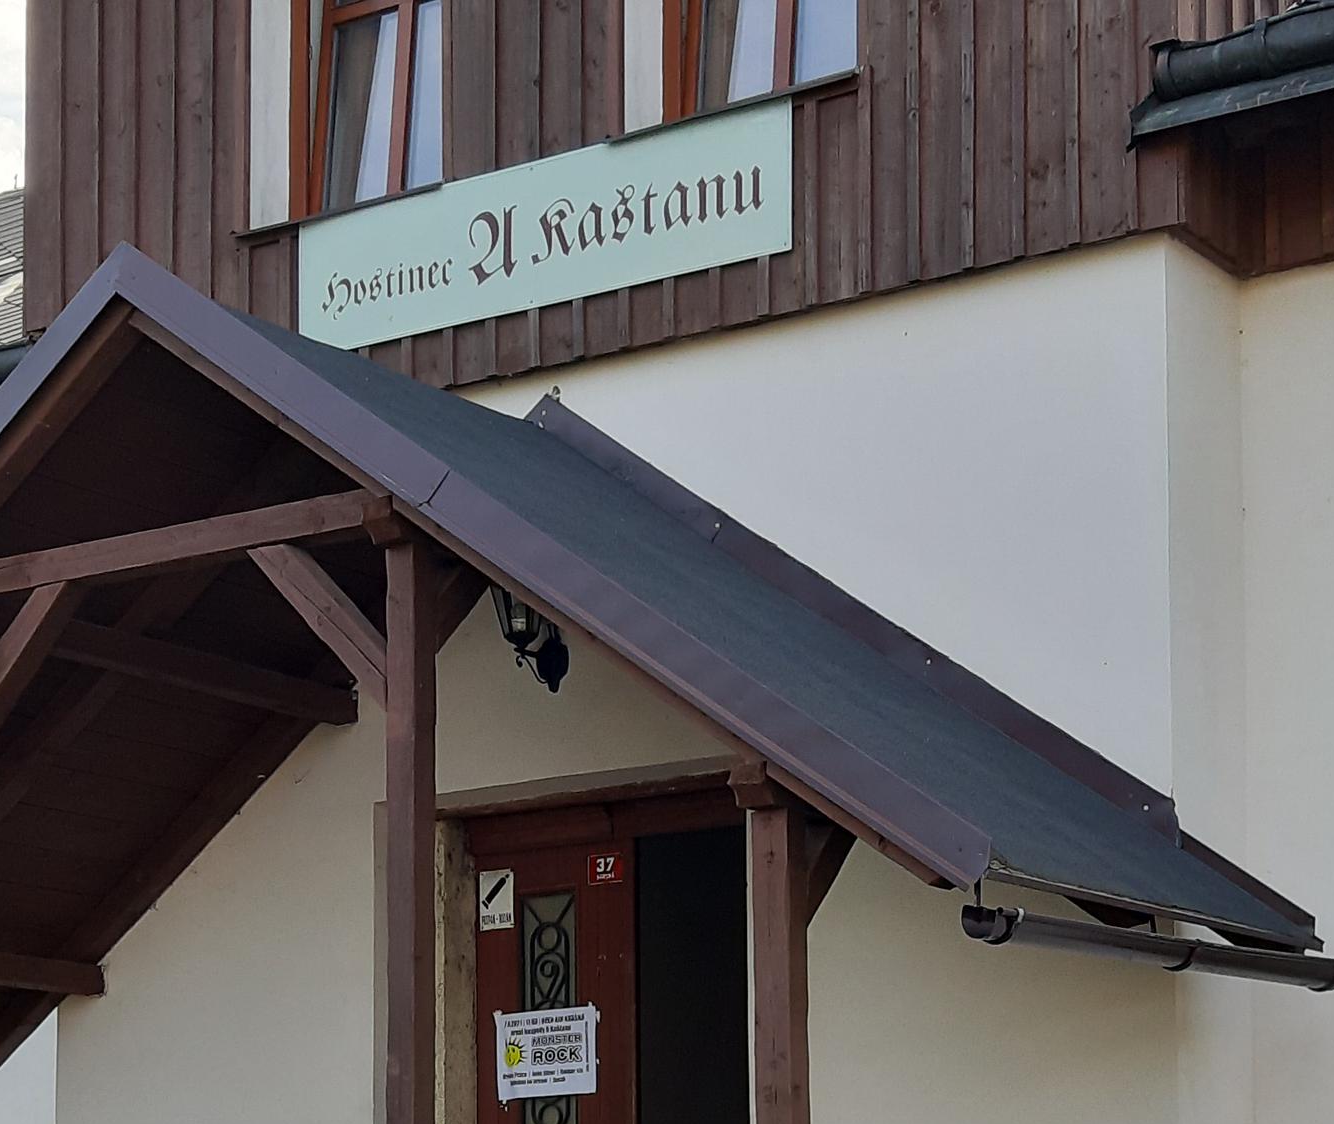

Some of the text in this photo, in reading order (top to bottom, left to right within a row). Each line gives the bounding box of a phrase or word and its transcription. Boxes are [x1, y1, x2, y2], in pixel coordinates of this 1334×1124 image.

[321, 258, 453, 320] Hostinec
[596, 857, 615, 873] 37
[531, 1045, 583, 1066] ROCK
